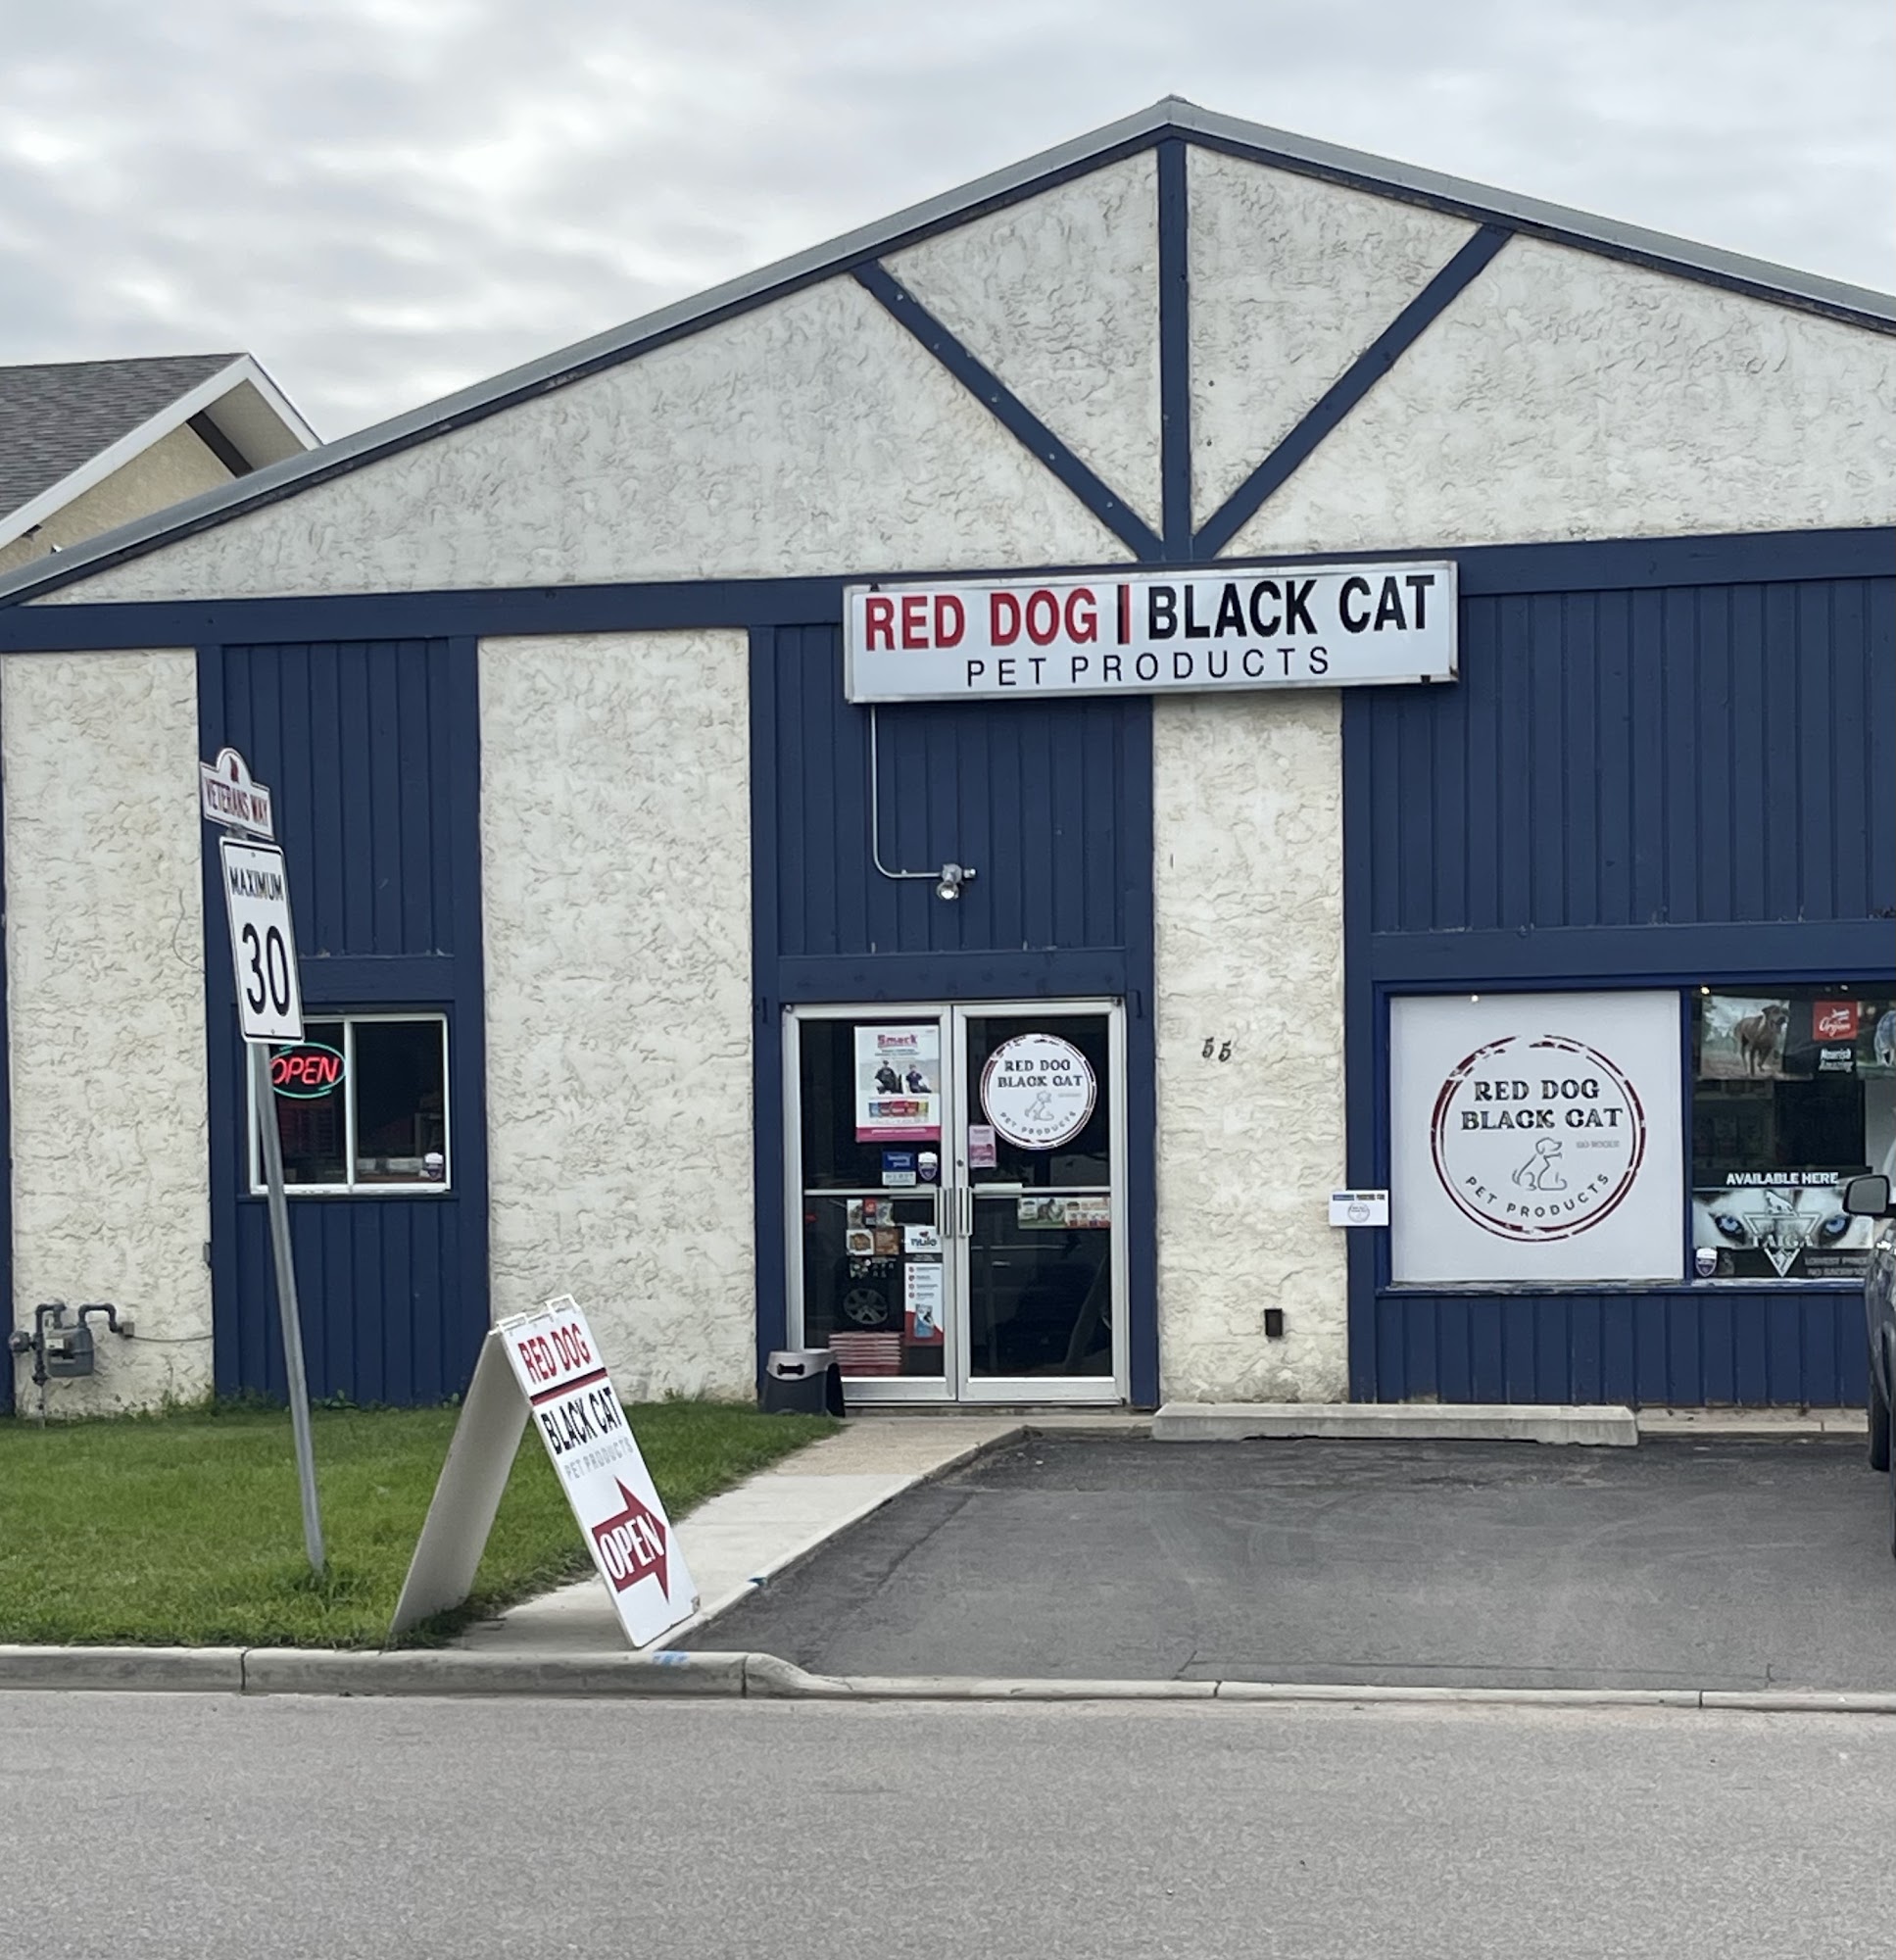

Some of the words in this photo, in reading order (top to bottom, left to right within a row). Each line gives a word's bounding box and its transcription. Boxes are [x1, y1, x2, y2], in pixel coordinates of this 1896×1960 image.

[865, 594, 965, 651] RED
[990, 588, 1097, 646] DOG
[1147, 579, 1318, 641] BLACK
[1338, 574, 1434, 633] CAT
[967, 658, 1045, 687] PET
[1071, 646, 1329, 683] PRODUCTS
[206, 777, 250, 821] VETERANS
[250, 795, 269, 827] WAY
[229, 866, 284, 901] MAXIMUM
[242, 922, 291, 1016] 30
[1004, 1060, 1034, 1072] RED
[1040, 1059, 1071, 1071] DOG
[1201, 1036, 1232, 1062] 55
[270, 1057, 339, 1085] OPEN
[997, 1076, 1047, 1088] BLACK
[1052, 1075, 1083, 1087] CAT
[1474, 1080, 1530, 1102] RED
[1541, 1078, 1600, 1100] DOG
[1461, 1108, 1555, 1130] BLACK
[1565, 1107, 1624, 1128] CAT
[1466, 1176, 1497, 1204] PET
[1506, 1173, 1609, 1218] PRODUCTS
[1726, 1172, 1799, 1186] AVAILABLE
[1802, 1172, 1839, 1185] HERE
[1753, 1234, 1814, 1248] TAIGA
[518, 1336, 557, 1384] RED
[551, 1323, 592, 1371] DOG
[540, 1396, 594, 1455] BLACK
[589, 1387, 623, 1435] CAT
[564, 1457, 586, 1481] PET
[585, 1437, 633, 1472] PRODUCTS
[600, 1512, 665, 1581] OPEN
